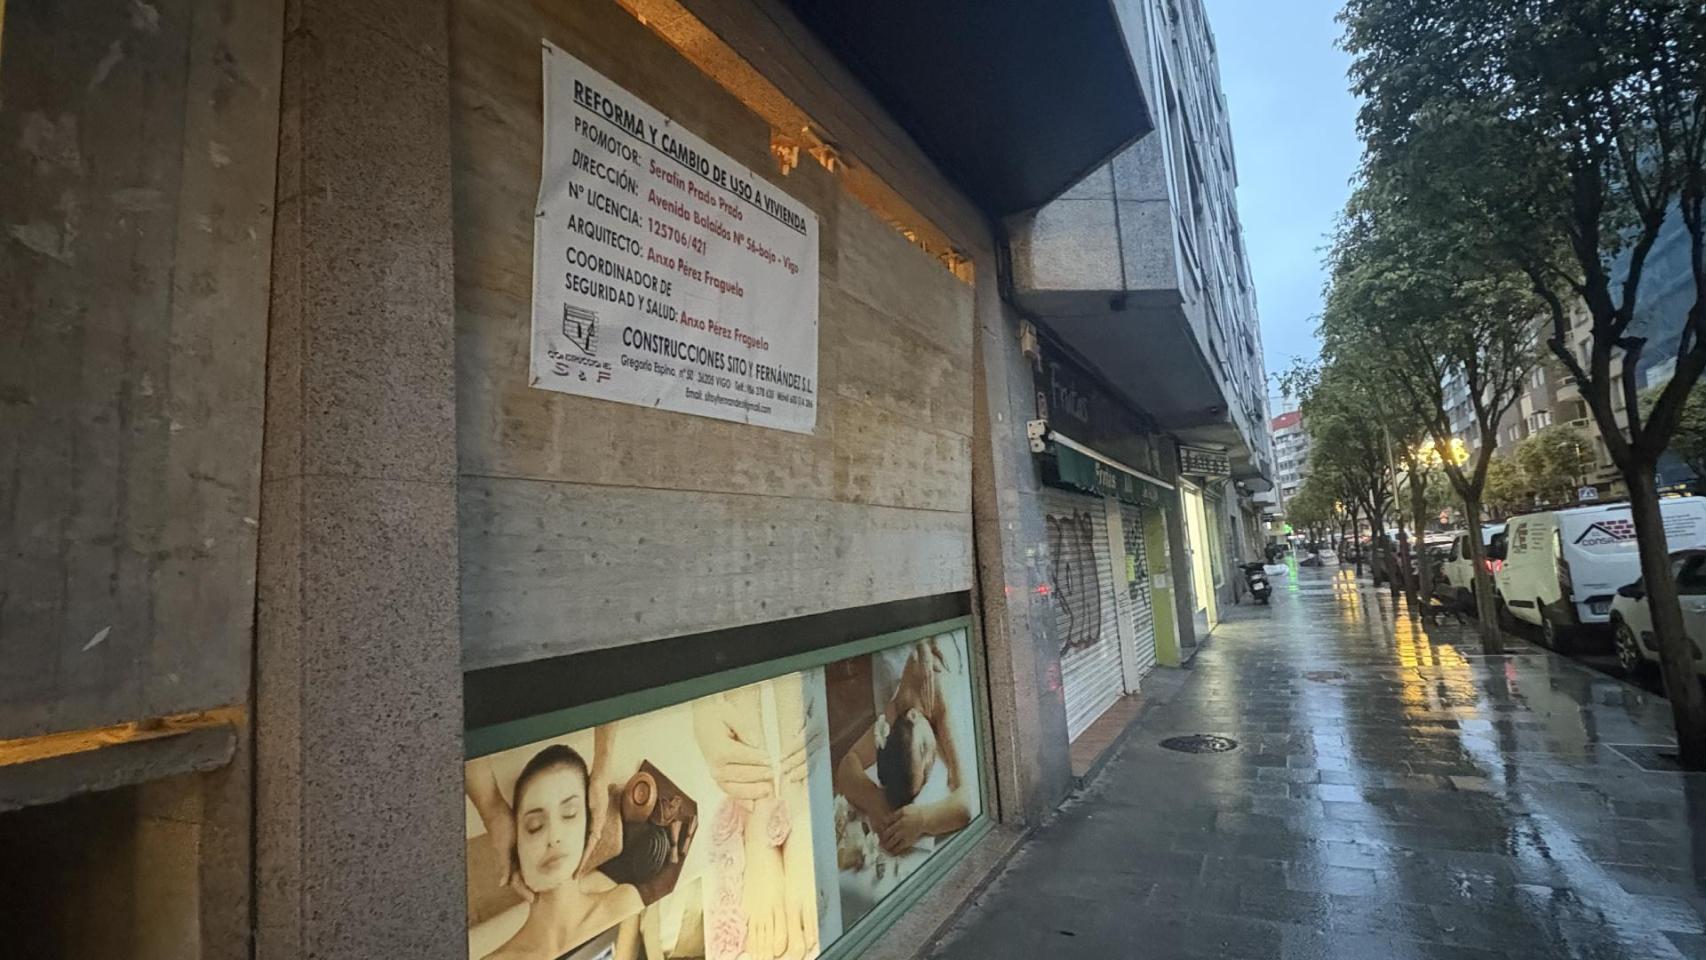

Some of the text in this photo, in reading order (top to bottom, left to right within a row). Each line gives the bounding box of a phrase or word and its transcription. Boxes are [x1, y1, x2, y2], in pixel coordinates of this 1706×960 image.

[574, 79, 807, 233] REFORMA Y CAMBIO DE USO A VIVIENDA
[574, 116, 642, 167] PROMOTOR:
[688, 181, 716, 207] Prado
[719, 194, 743, 221] Prado
[568, 181, 584, 199] Nº
[588, 188, 642, 228] LICENCIA:
[572, 149, 639, 196] DIRECCIÓN:
[648, 189, 690, 221] Avenida
[783, 255, 799, 275] Vigo
[567, 215, 744, 298] ARQUITECTO: Anxo Pérez Fraguela
[567, 246, 672, 297] COORDINADOR DE
[565, 272, 769, 352] SEGURIDAD Y SALUD: Anxo Pérez Fraguela
[622, 326, 726, 371] CONSTRUCCIONES
[727, 353, 747, 377] SITO
[756, 362, 802, 391] FERNÁNDEZ
[716, 376, 732, 389] VIGO
